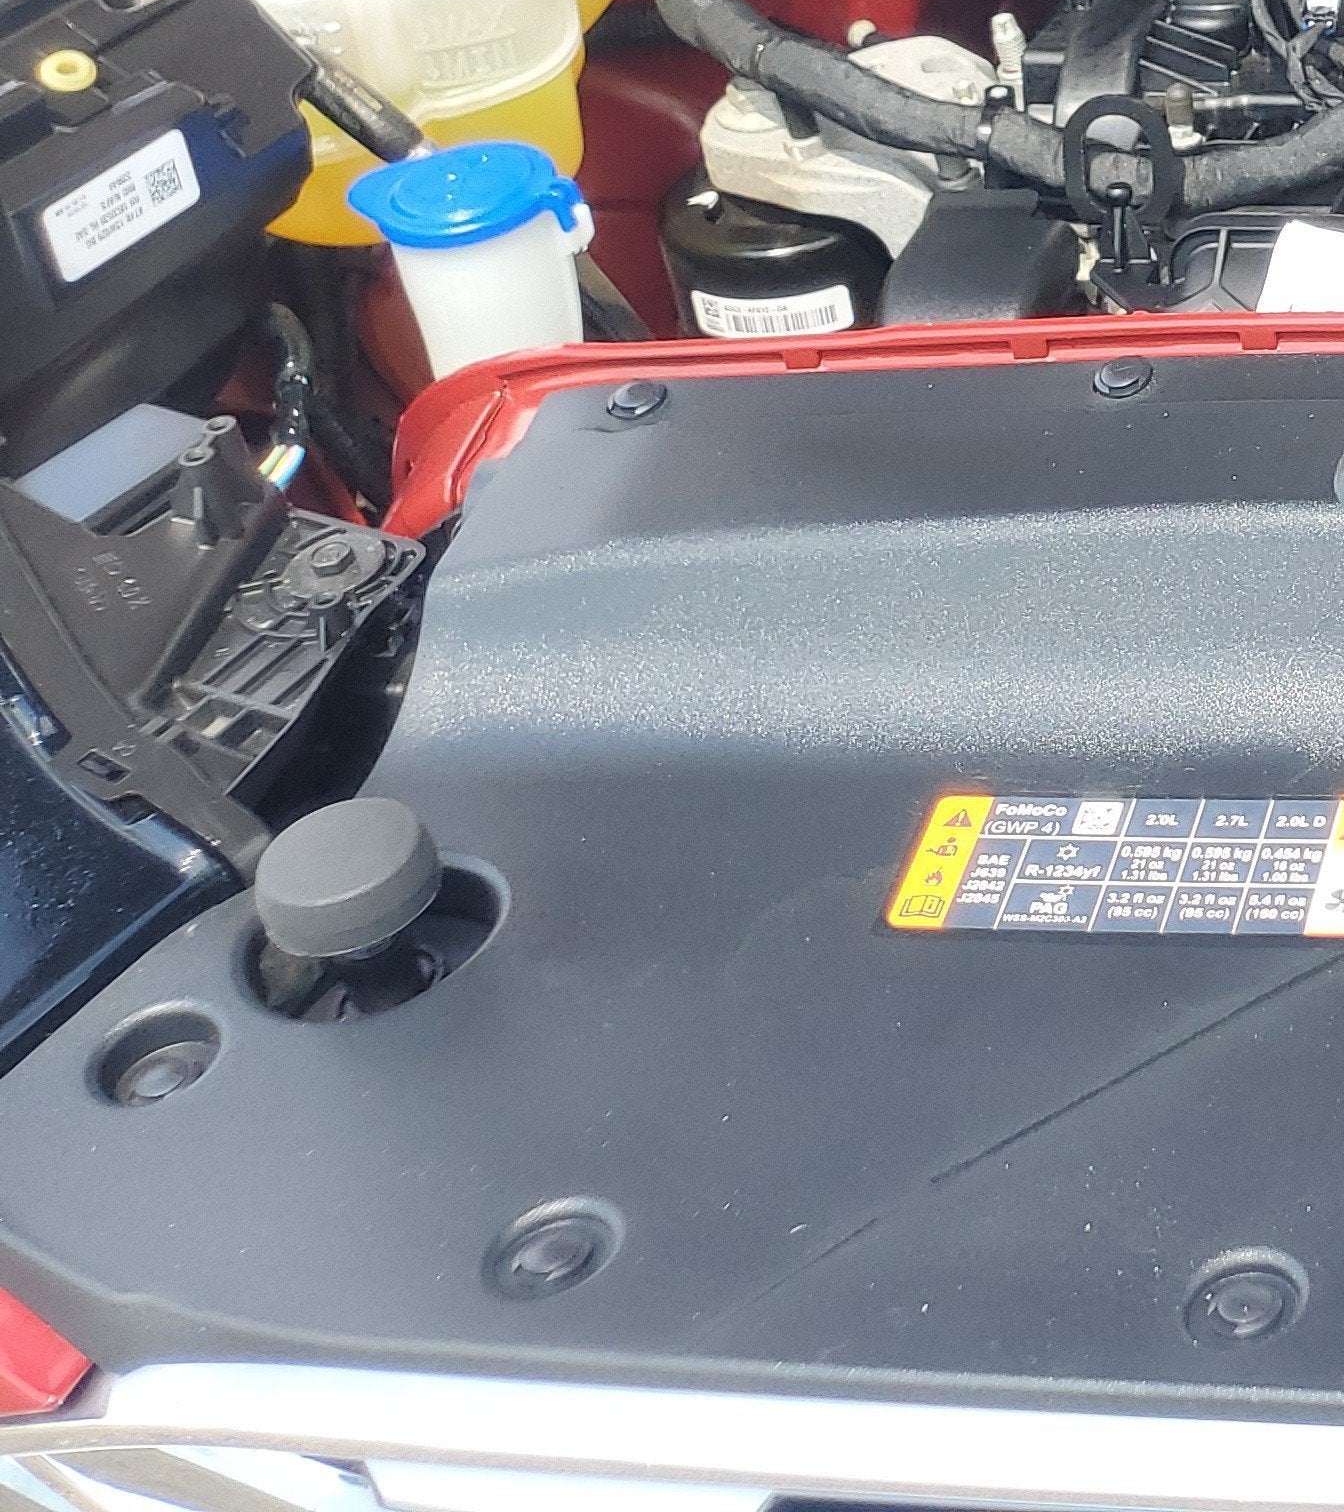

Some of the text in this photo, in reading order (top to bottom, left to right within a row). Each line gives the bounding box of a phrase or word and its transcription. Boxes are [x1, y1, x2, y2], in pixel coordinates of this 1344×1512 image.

[995, 804, 1068, 816] FoMoCo
[1215, 815, 1249, 827] 2.7L
[985, 821, 1060, 835] (GWP 4)
[1163, 847, 1182, 861] kg
[1234, 847, 1252, 862] kg
[1303, 848, 1323, 863] kg
[1130, 859, 1164, 870] 21 oz
[1201, 860, 1235, 870] 21 oz
[1289, 863, 1305, 871] oz
[1025, 864, 1101, 879] R-1234yf
[1107, 892, 1130, 903] 3.2
[1146, 895, 1165, 904] oz
[1179, 894, 1202, 904] 3.2
[1218, 896, 1237, 905] oz
[1287, 898, 1306, 906] oz
[1029, 902, 1068, 914] PAG
